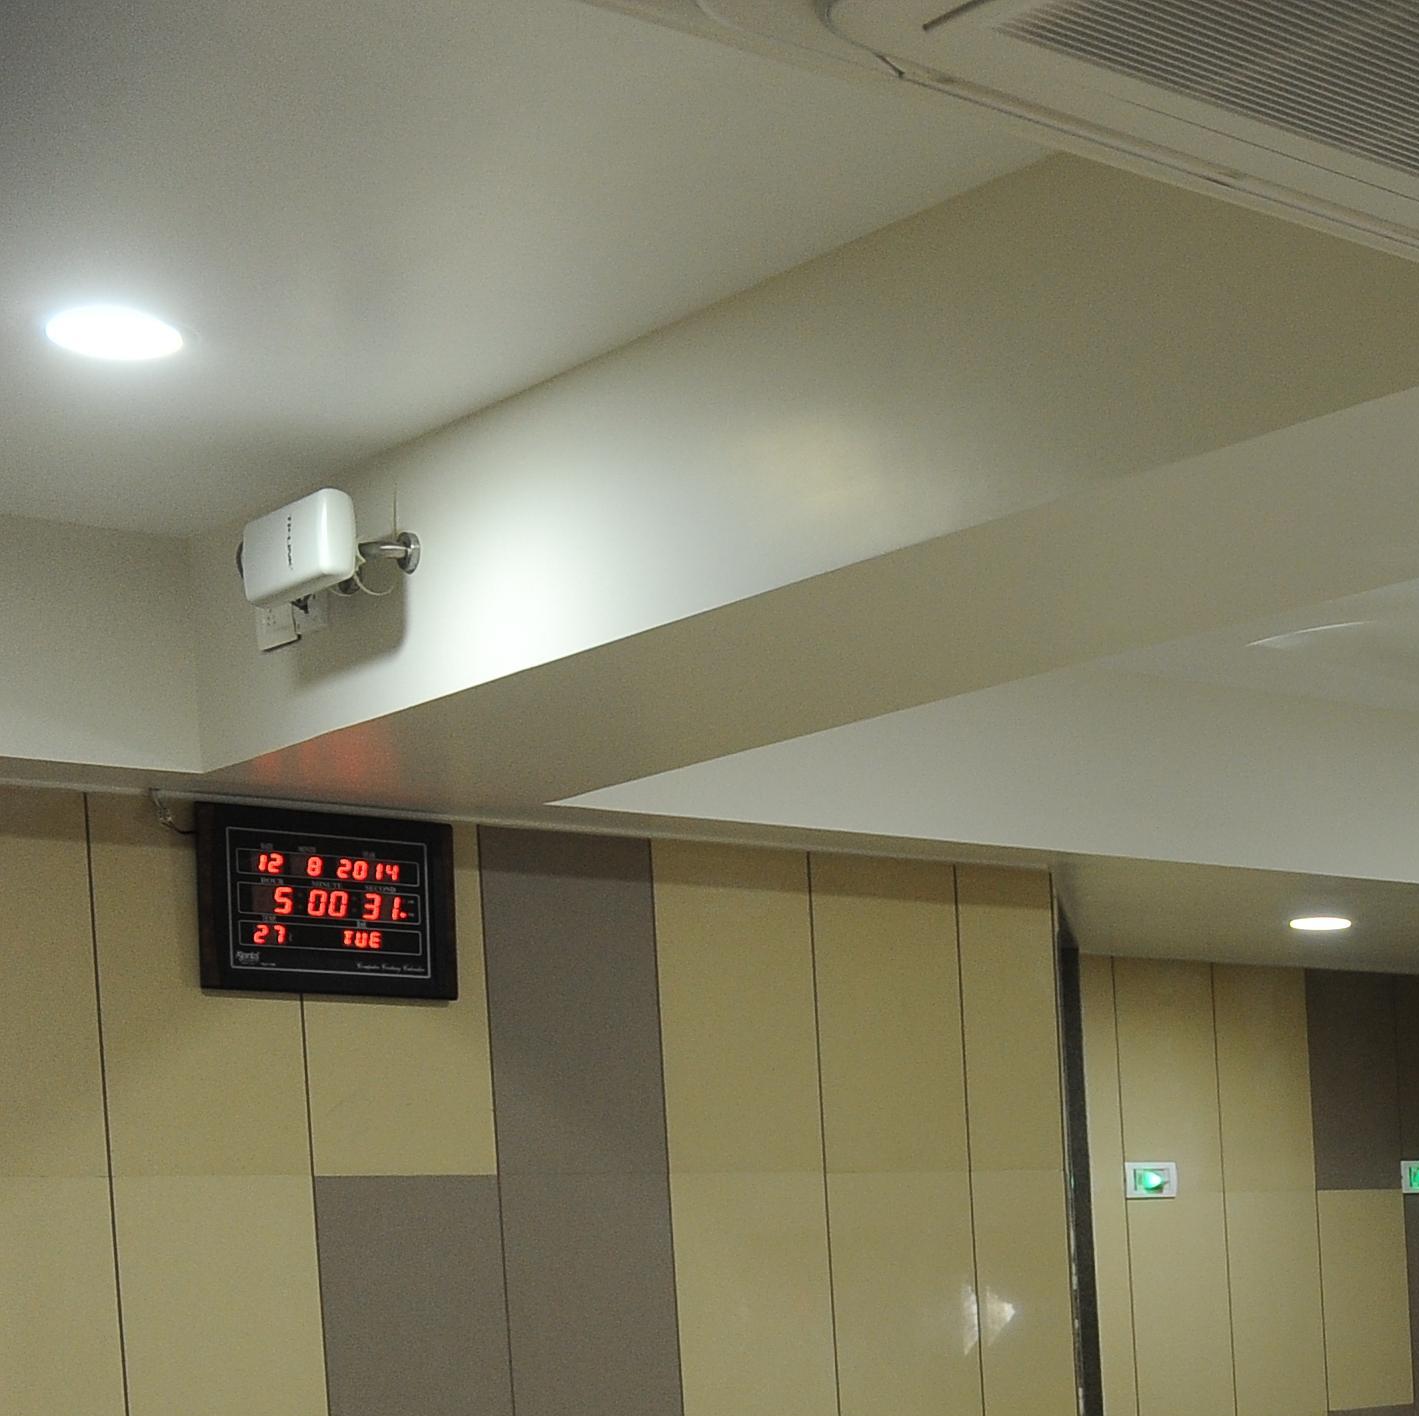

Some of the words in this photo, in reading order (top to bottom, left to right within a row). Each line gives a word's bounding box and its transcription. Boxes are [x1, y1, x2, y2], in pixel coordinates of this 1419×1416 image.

[257, 852, 284, 875] 12
[306, 856, 323, 877] 8
[336, 857, 400, 881] 2014
[273, 886, 293, 915] 5
[307, 888, 349, 918] 00
[253, 924, 288, 944] 27
[343, 929, 382, 949] TUE
